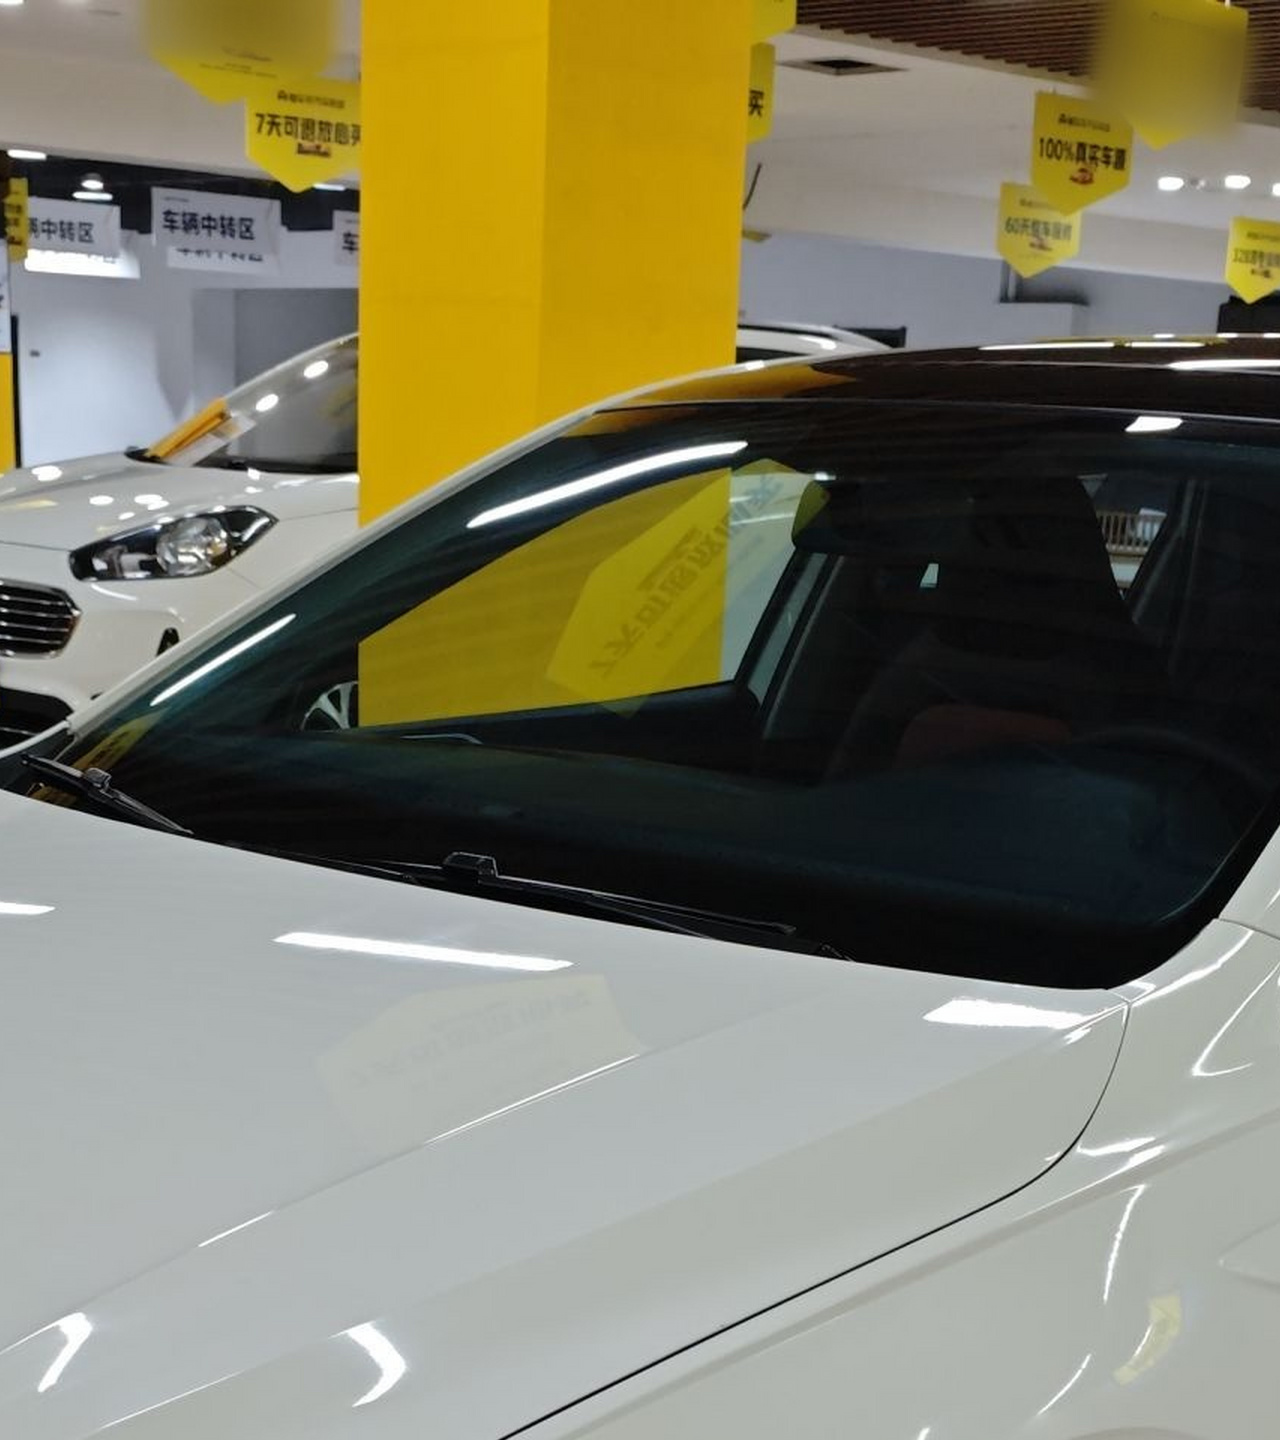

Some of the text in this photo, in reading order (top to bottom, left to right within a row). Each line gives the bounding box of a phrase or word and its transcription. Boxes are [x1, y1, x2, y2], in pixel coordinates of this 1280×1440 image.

[162, 208, 255, 241] 车辆中转区
